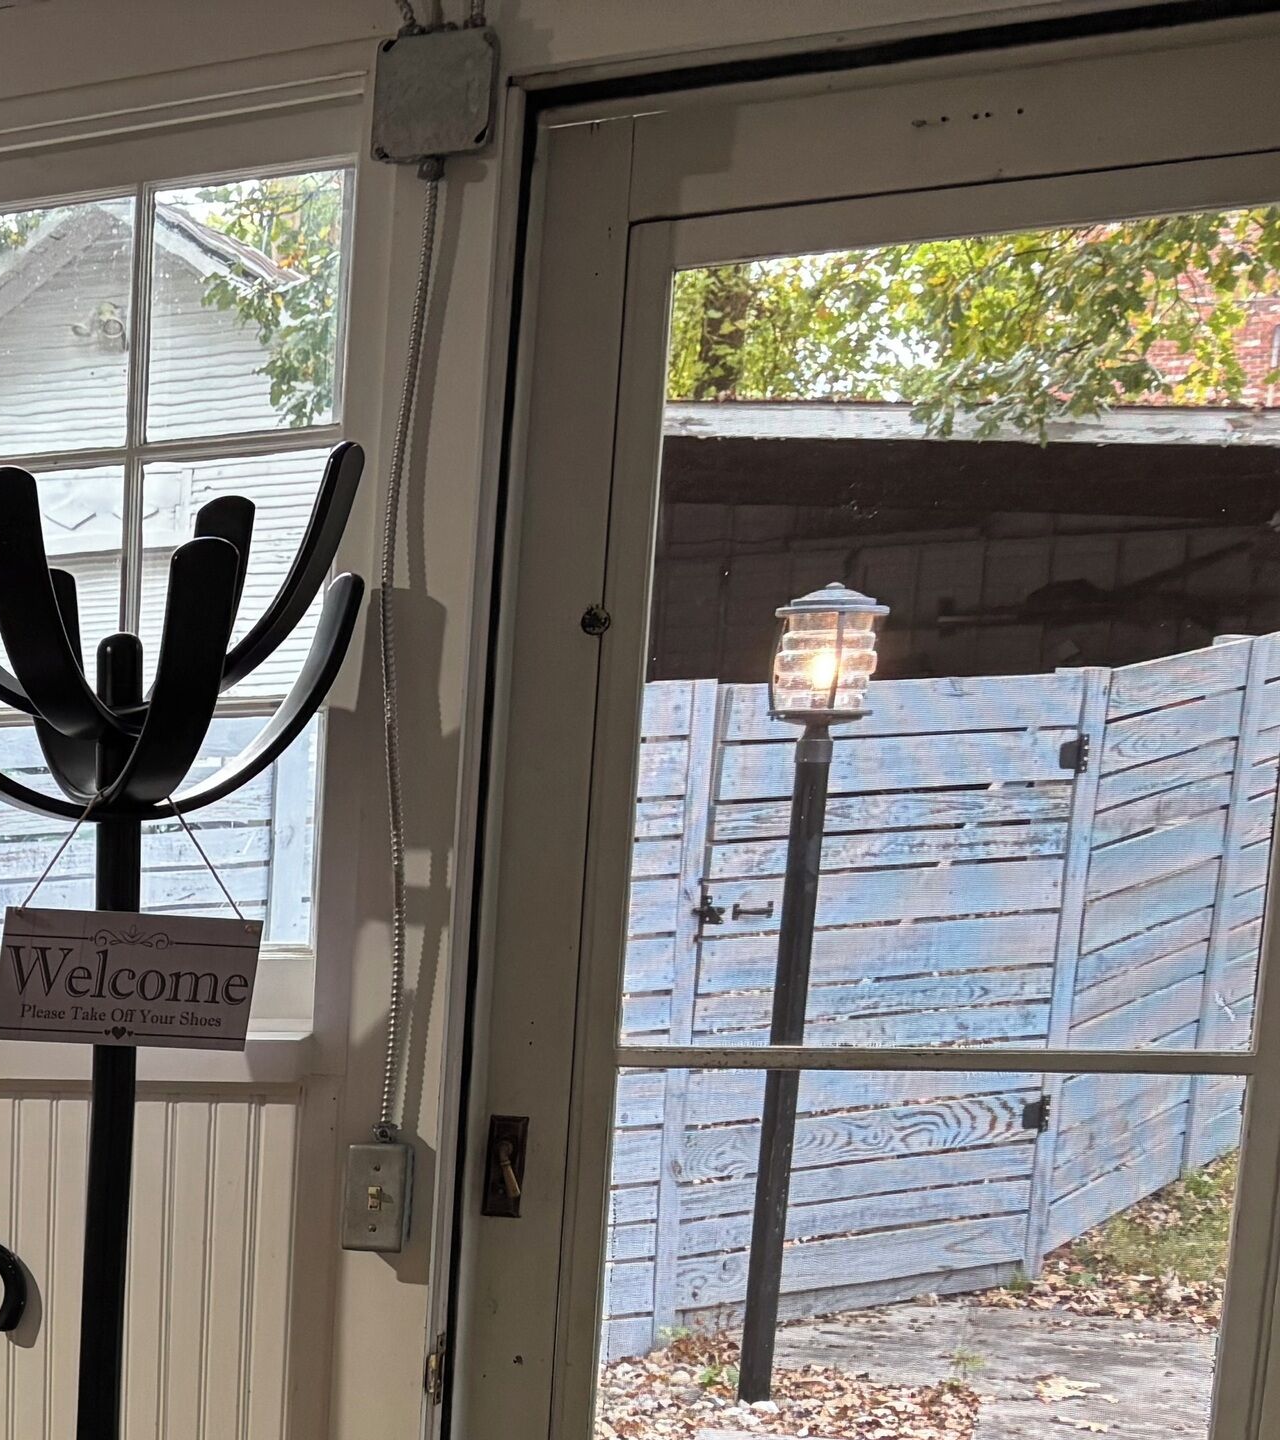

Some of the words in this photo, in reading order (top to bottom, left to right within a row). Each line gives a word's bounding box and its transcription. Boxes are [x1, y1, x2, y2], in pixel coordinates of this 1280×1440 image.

[6, 944, 249, 1005] Welcome
[21, 1004, 66, 1020] Please
[71, 1006, 106, 1022] Take
[111, 1008, 138, 1023] Off
[139, 1010, 176, 1025] Your
[179, 1012, 222, 1028] Shoes
